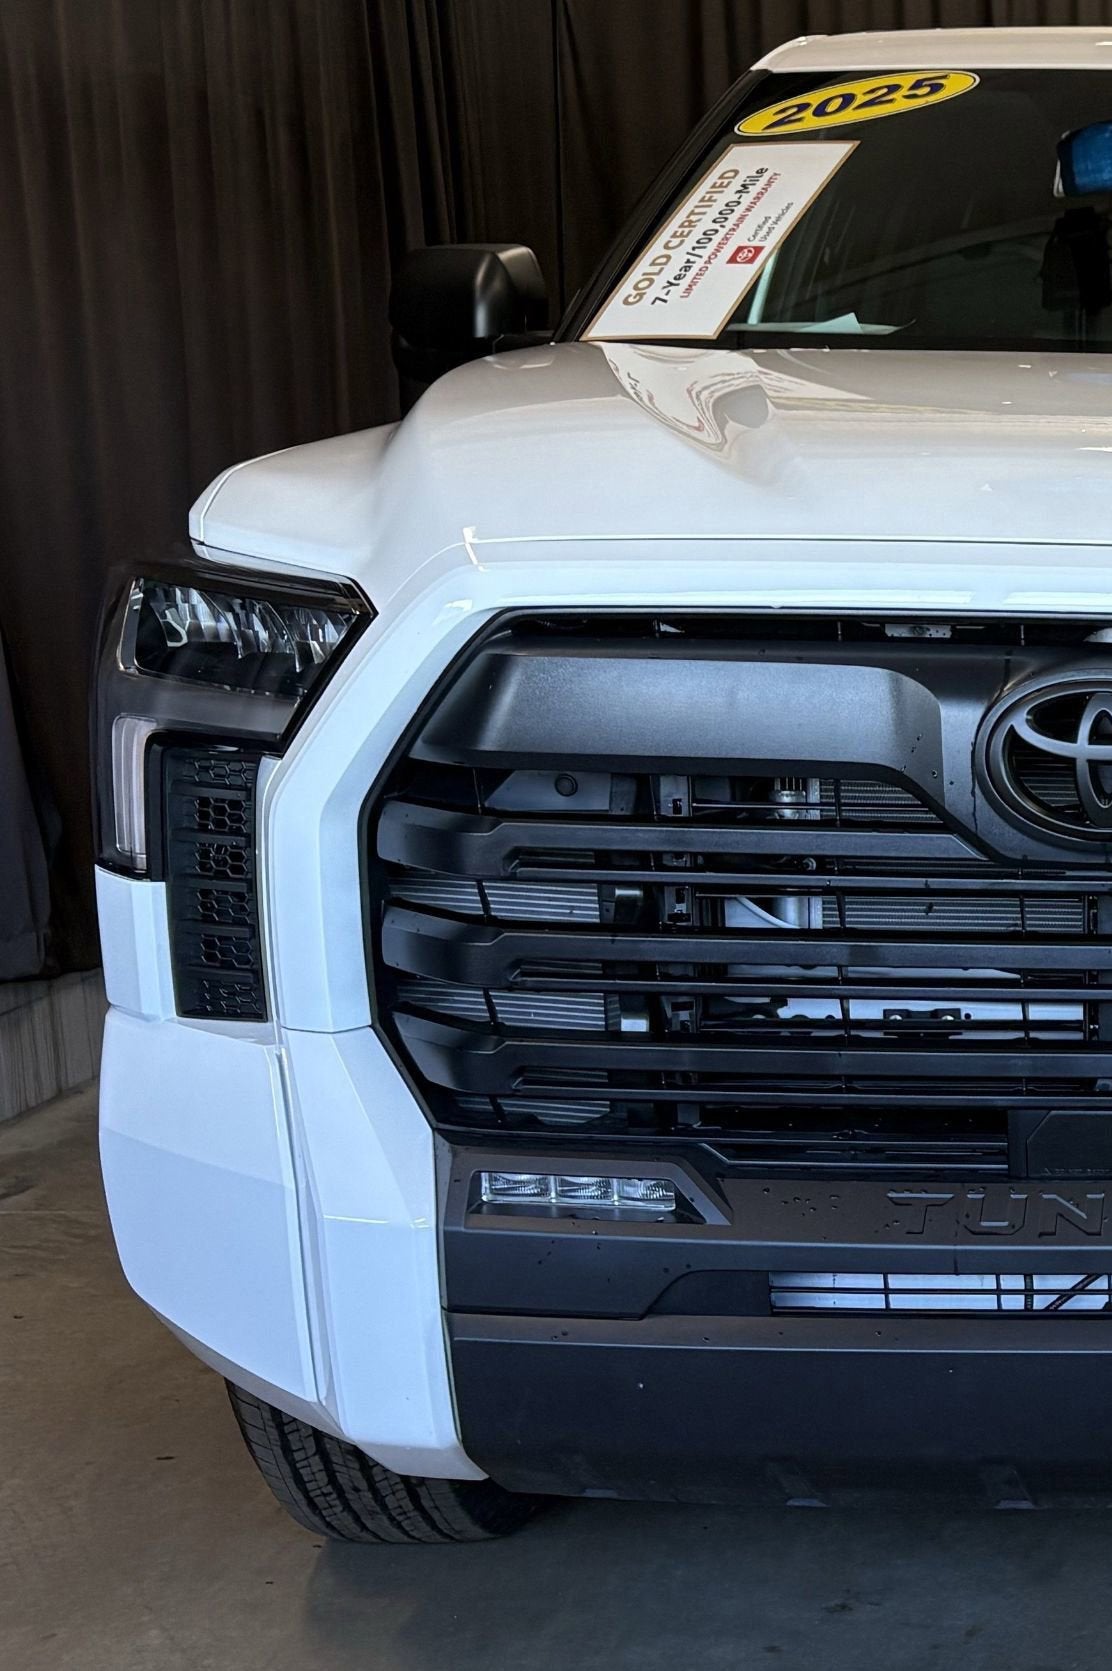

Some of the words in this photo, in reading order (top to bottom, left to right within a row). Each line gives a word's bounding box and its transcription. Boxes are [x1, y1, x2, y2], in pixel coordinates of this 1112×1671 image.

[761, 74, 950, 131] 2025
[622, 254, 672, 306] GOLD
[663, 169, 740, 251] CERTIFIED
[650, 167, 768, 305] 7-Year/100,000-Mile
[680, 265, 709, 298] LIMITED
[704, 213, 749, 265] POWERTRAIN
[743, 172, 781, 213] WARRANTY
[747, 215, 771, 242] Certified
[758, 226, 775, 242] Used
[770, 202, 794, 227] Vehicles
